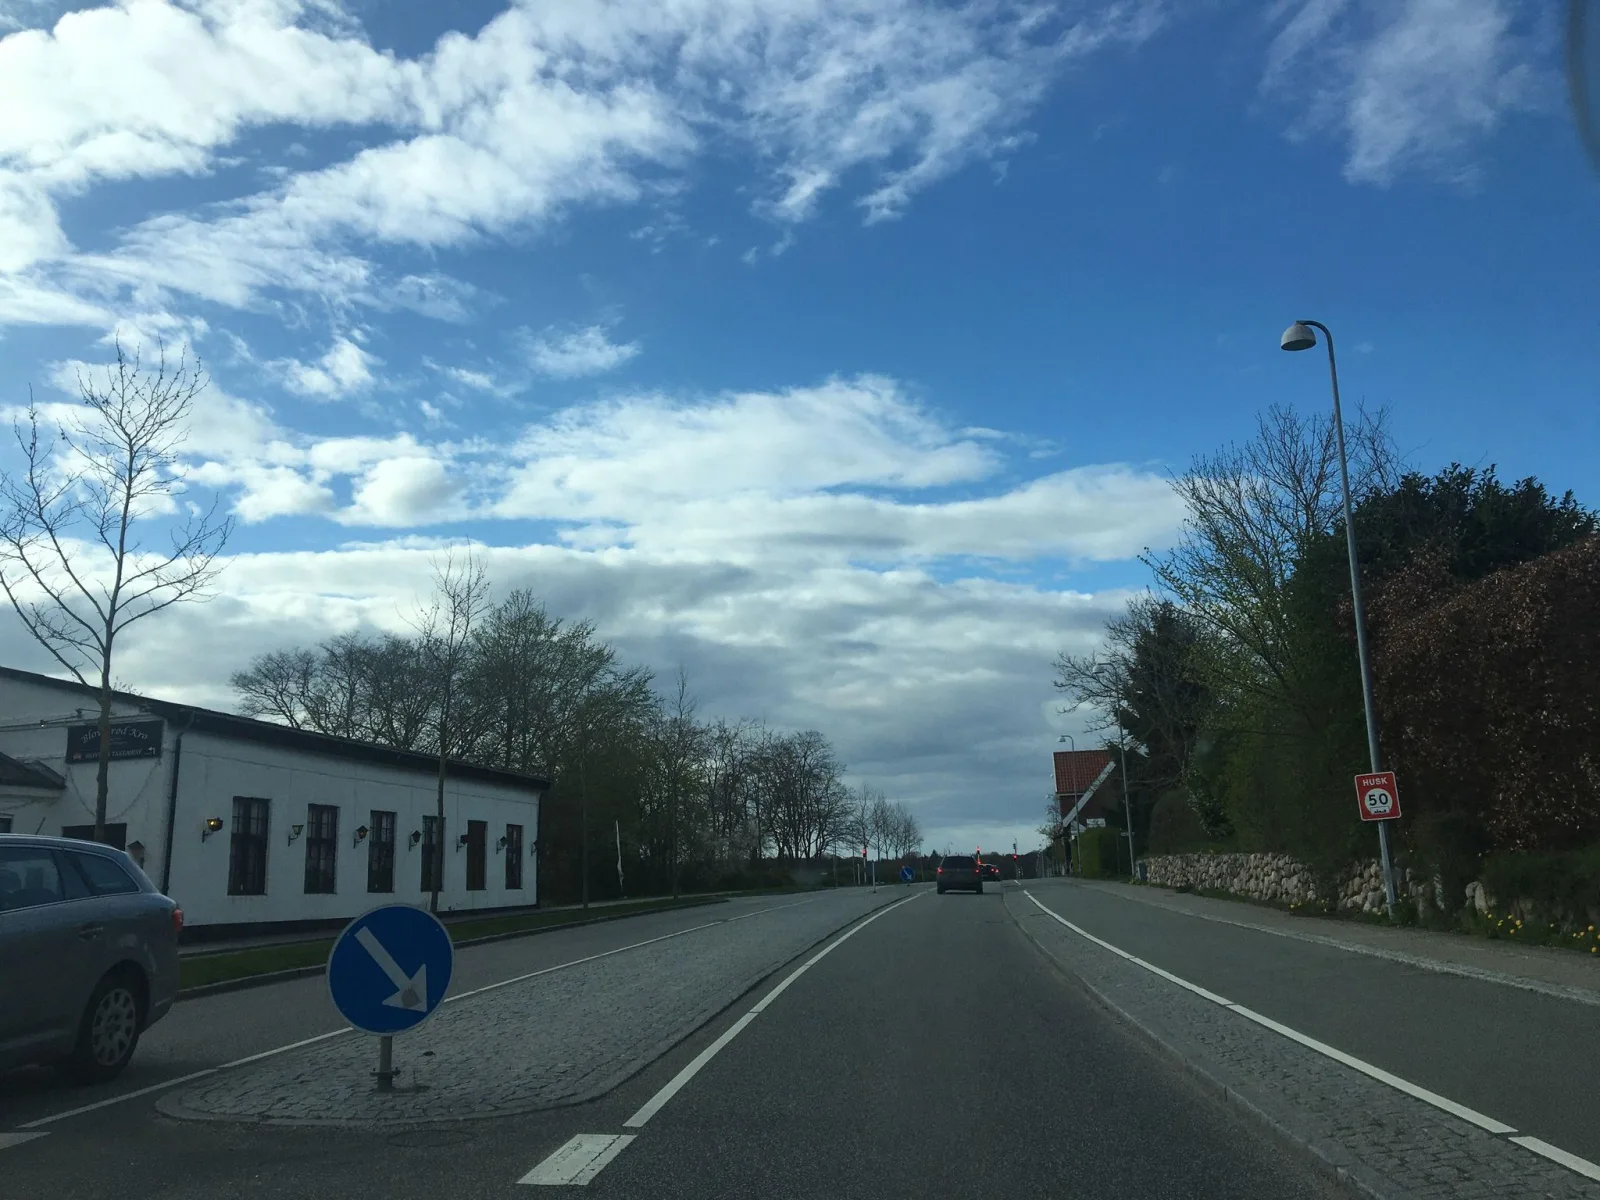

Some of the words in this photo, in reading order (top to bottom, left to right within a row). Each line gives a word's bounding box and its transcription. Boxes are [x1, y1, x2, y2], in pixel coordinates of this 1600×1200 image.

[81, 726, 130, 744] Blovrød
[1362, 777, 1388, 787] HUSK
[1368, 793, 1389, 806] 50
